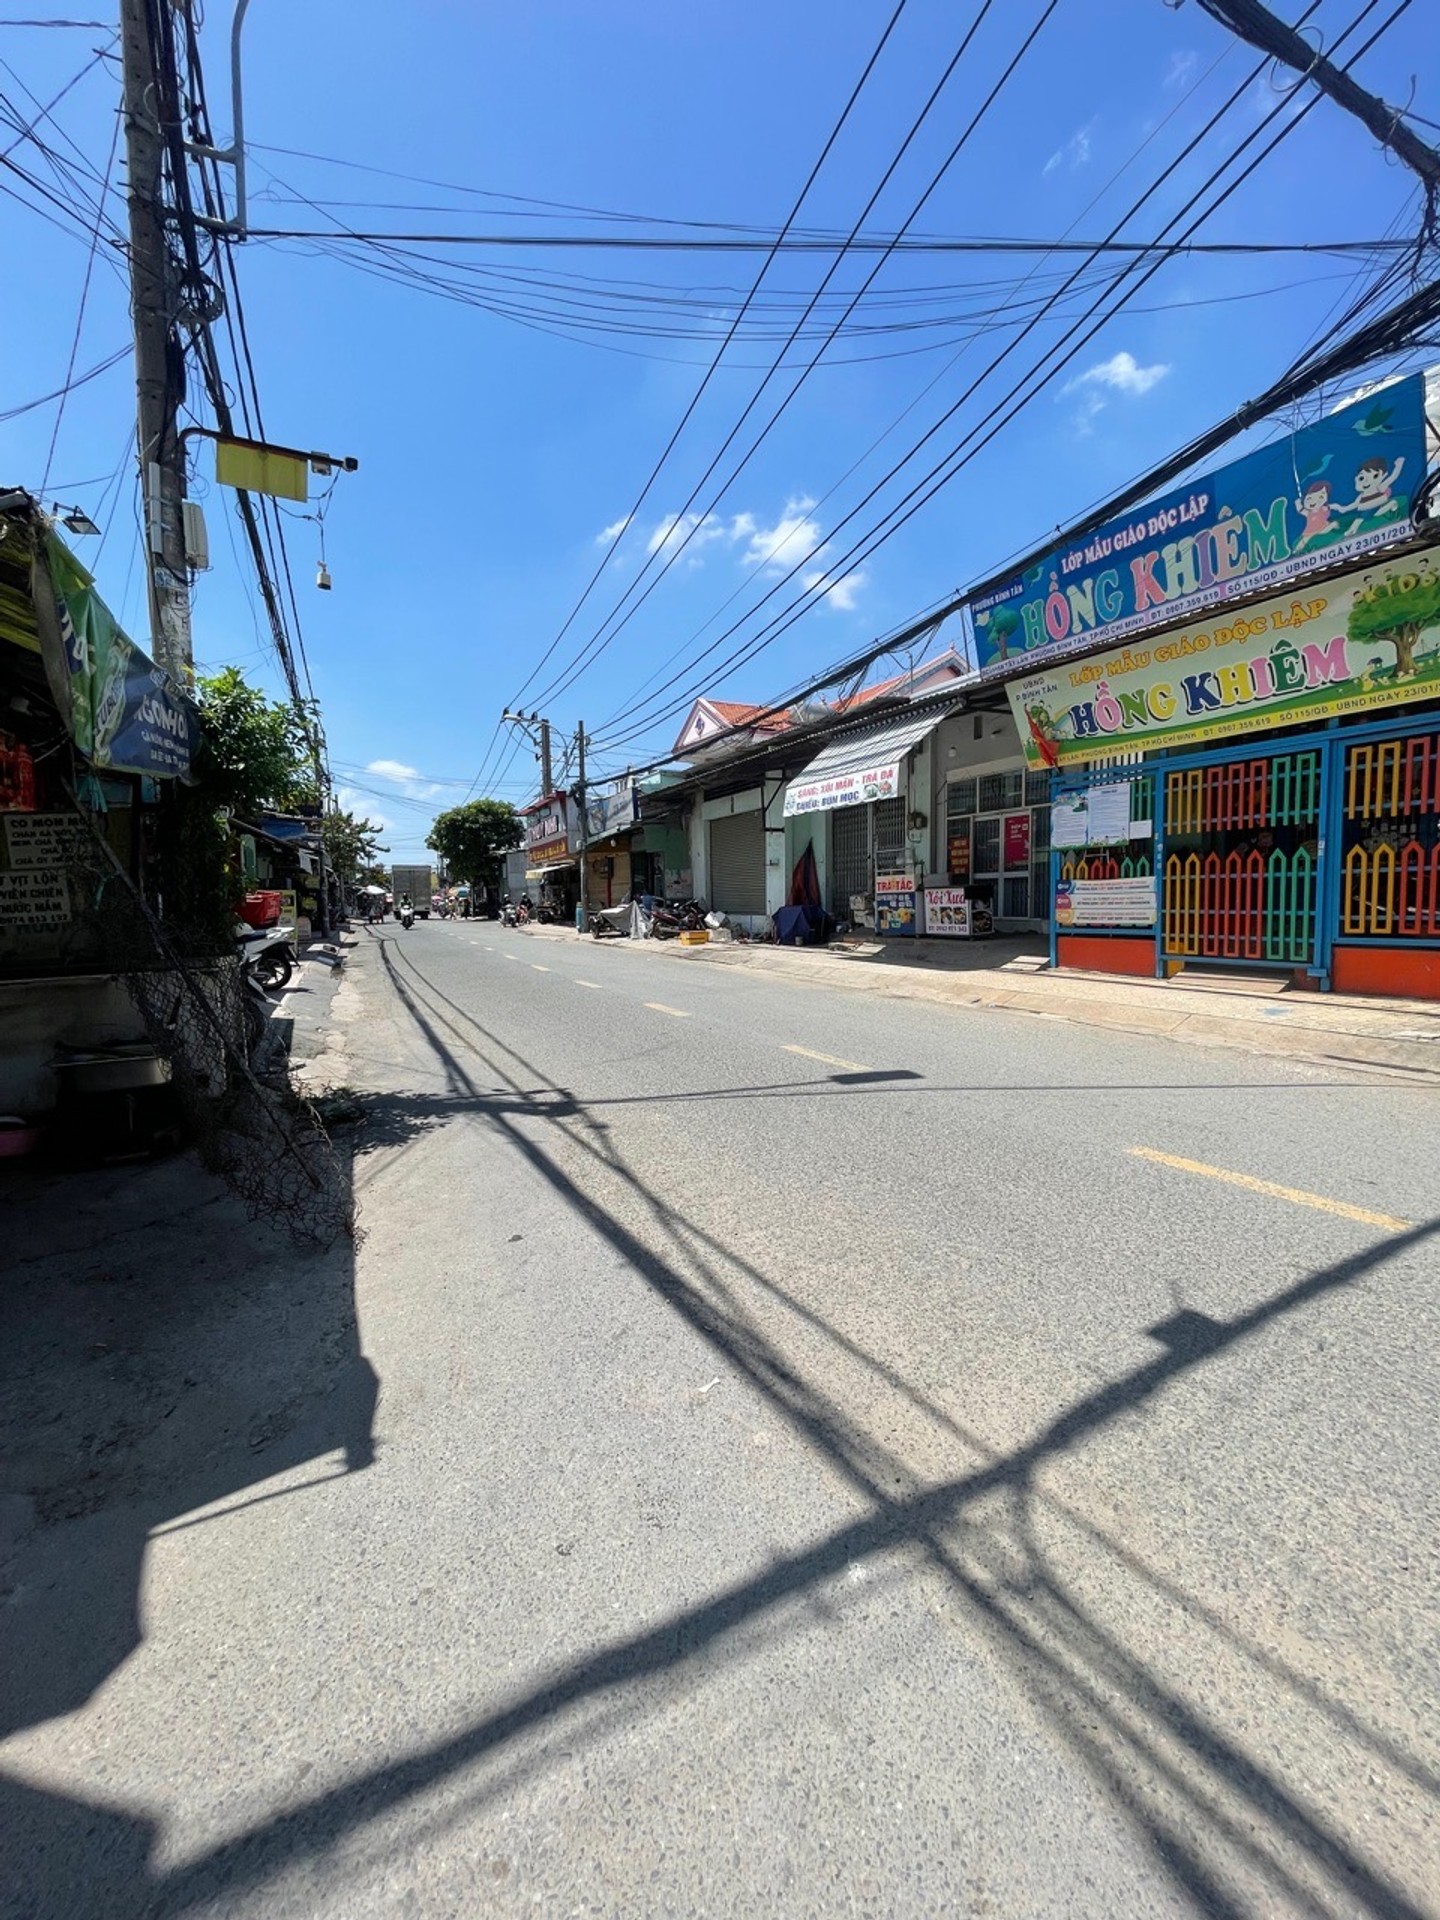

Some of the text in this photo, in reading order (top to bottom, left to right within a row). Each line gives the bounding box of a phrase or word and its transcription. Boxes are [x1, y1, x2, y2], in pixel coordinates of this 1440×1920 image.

[1020, 496, 1291, 650] HỒNG KHIÊM
[1061, 493, 1209, 574] LỚP MẪU GIÁO ĐỘC LẬP
[1125, 617, 1144, 631] MINH
[1285, 557, 1317, 575] UBND
[1320, 541, 1352, 561] NGÀY
[1355, 522, 1414, 550] 23/01/201
[1022, 676, 1046, 690] UBND
[1068, 598, 1328, 688] LỚP MẪU GIÁO ĐỘC LẬP
[1069, 636, 1351, 738] HỒNG KHIÊM
[1336, 698, 1367, 711] UBND
[9, 875, 28, 887] VỊT
[35, 871, 58, 885] LỘN
